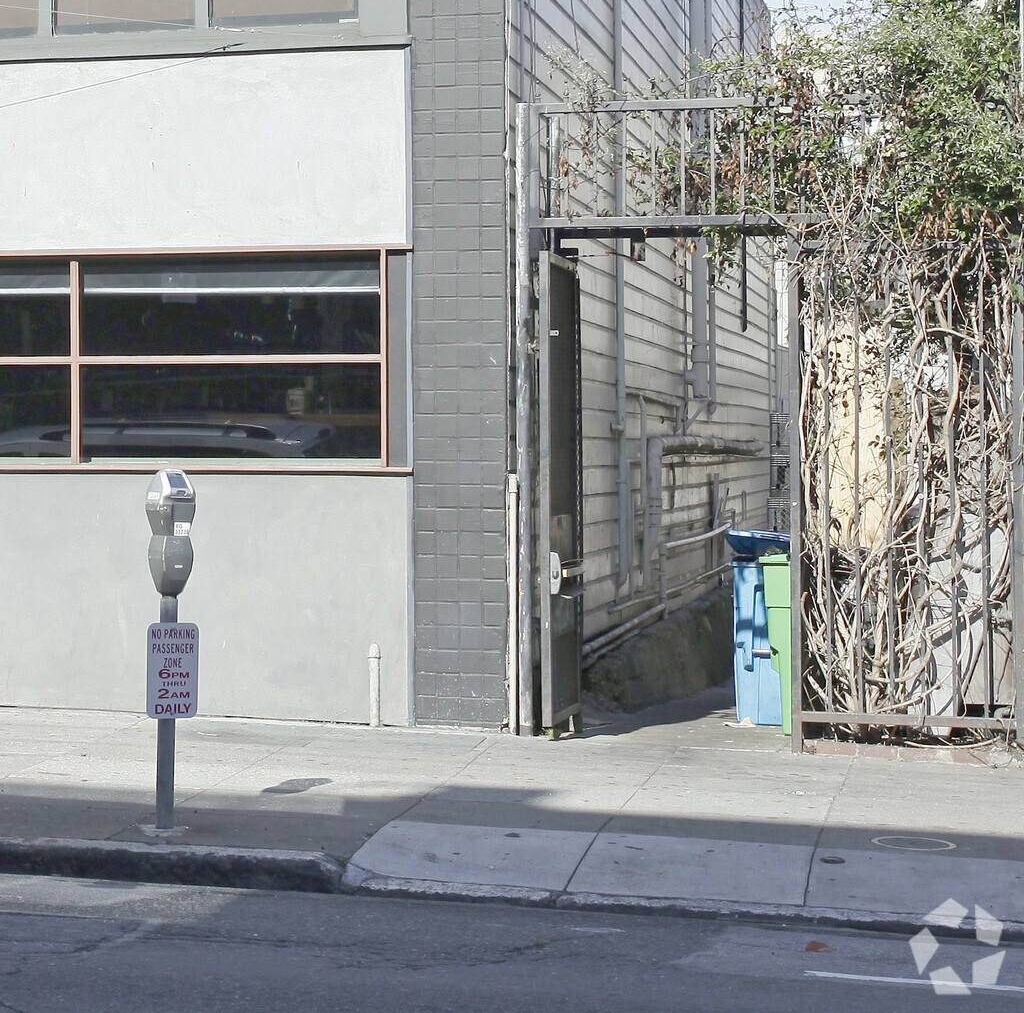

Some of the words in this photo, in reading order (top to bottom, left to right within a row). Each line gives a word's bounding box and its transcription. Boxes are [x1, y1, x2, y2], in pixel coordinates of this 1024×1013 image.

[151, 629, 162, 639] NO
[164, 629, 195, 639] PARKING
[152, 643, 194, 654] PASSENGER
[163, 657, 182, 668] ZONE
[158, 668, 190, 679] 6PM
[157, 688, 191, 699] 2AM
[154, 703, 192, 715] DAILY
